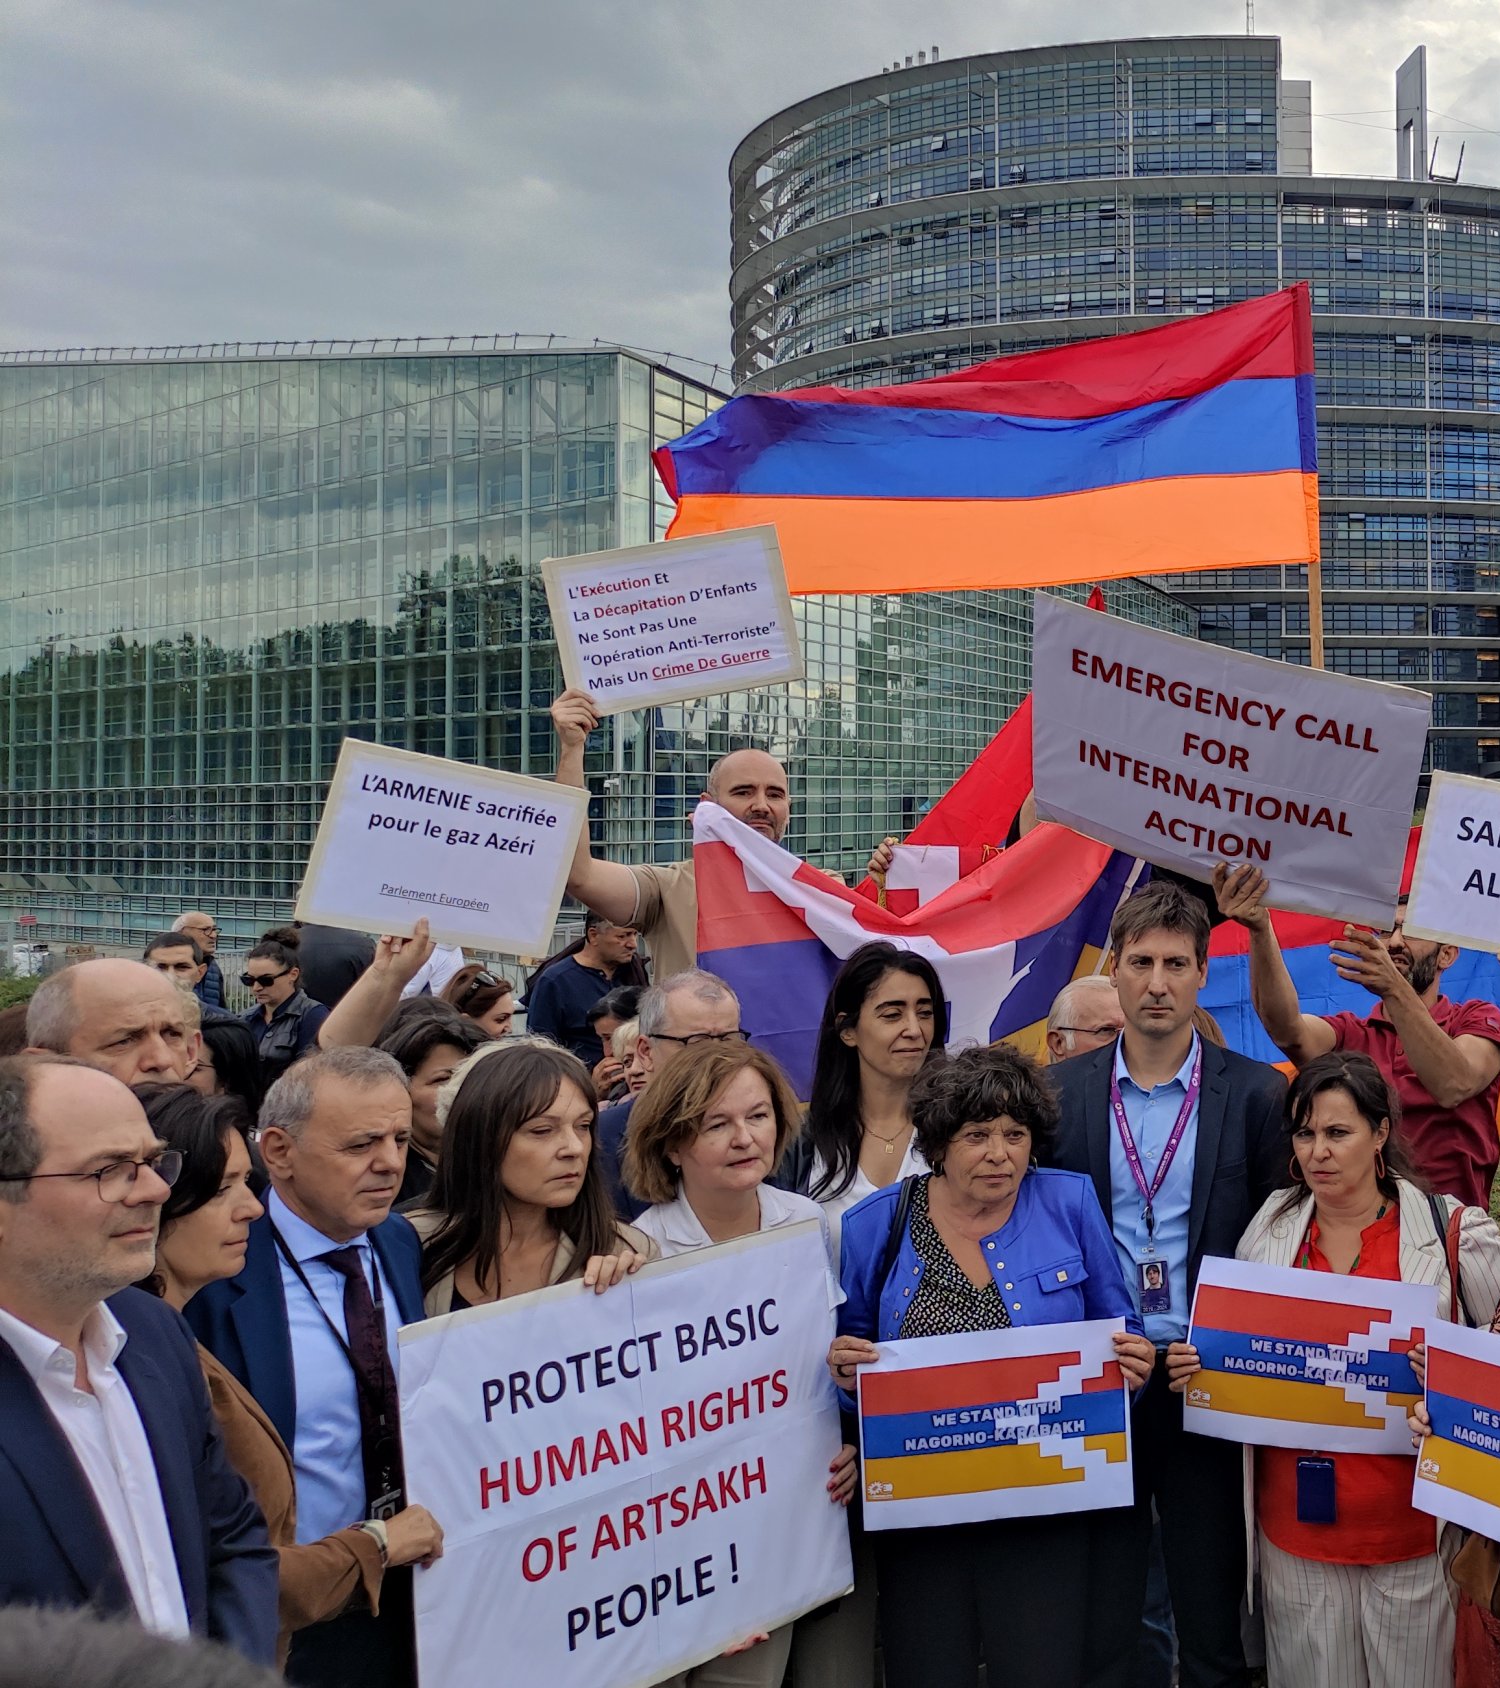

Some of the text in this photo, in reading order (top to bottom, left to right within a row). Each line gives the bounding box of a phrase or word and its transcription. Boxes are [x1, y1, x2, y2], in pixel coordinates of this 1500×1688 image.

[568, 572, 669, 599] L'Exécution Et
[574, 609, 590, 622] La
[594, 592, 686, 619] Décapitation
[578, 614, 697, 645] Ne Sont Pas Une
[588, 647, 771, 691] Mais Un Crime De Guerre
[1071, 647, 1379, 753] EMERGENCY CALL
[1183, 732, 1250, 773] FOR
[1079, 739, 1353, 837] INTERNATIONAL
[476, 800, 557, 828] sacrifiée
[367, 811, 536, 856] pour le gaz Azéri
[1144, 810, 1272, 862] ACTION
[380, 882, 490, 911] Parlement Européen
[482, 1298, 780, 1423] PROTECT BASIC
[1250, 1338, 1369, 1365] WE STAND WITH
[1224, 1355, 1389, 1388] NAGORNO-KARABAKH
[932, 1400, 1061, 1428] WE STAND WITH
[1472, 1408, 1490, 1426] WE
[479, 1369, 789, 1509] HUMAN RIGHTS
[905, 1419, 1085, 1452] NAGORNO-KARABAKH
[521, 1456, 768, 1583] OF ARTSAKH
[567, 1542, 740, 1652] PEOPLE !
